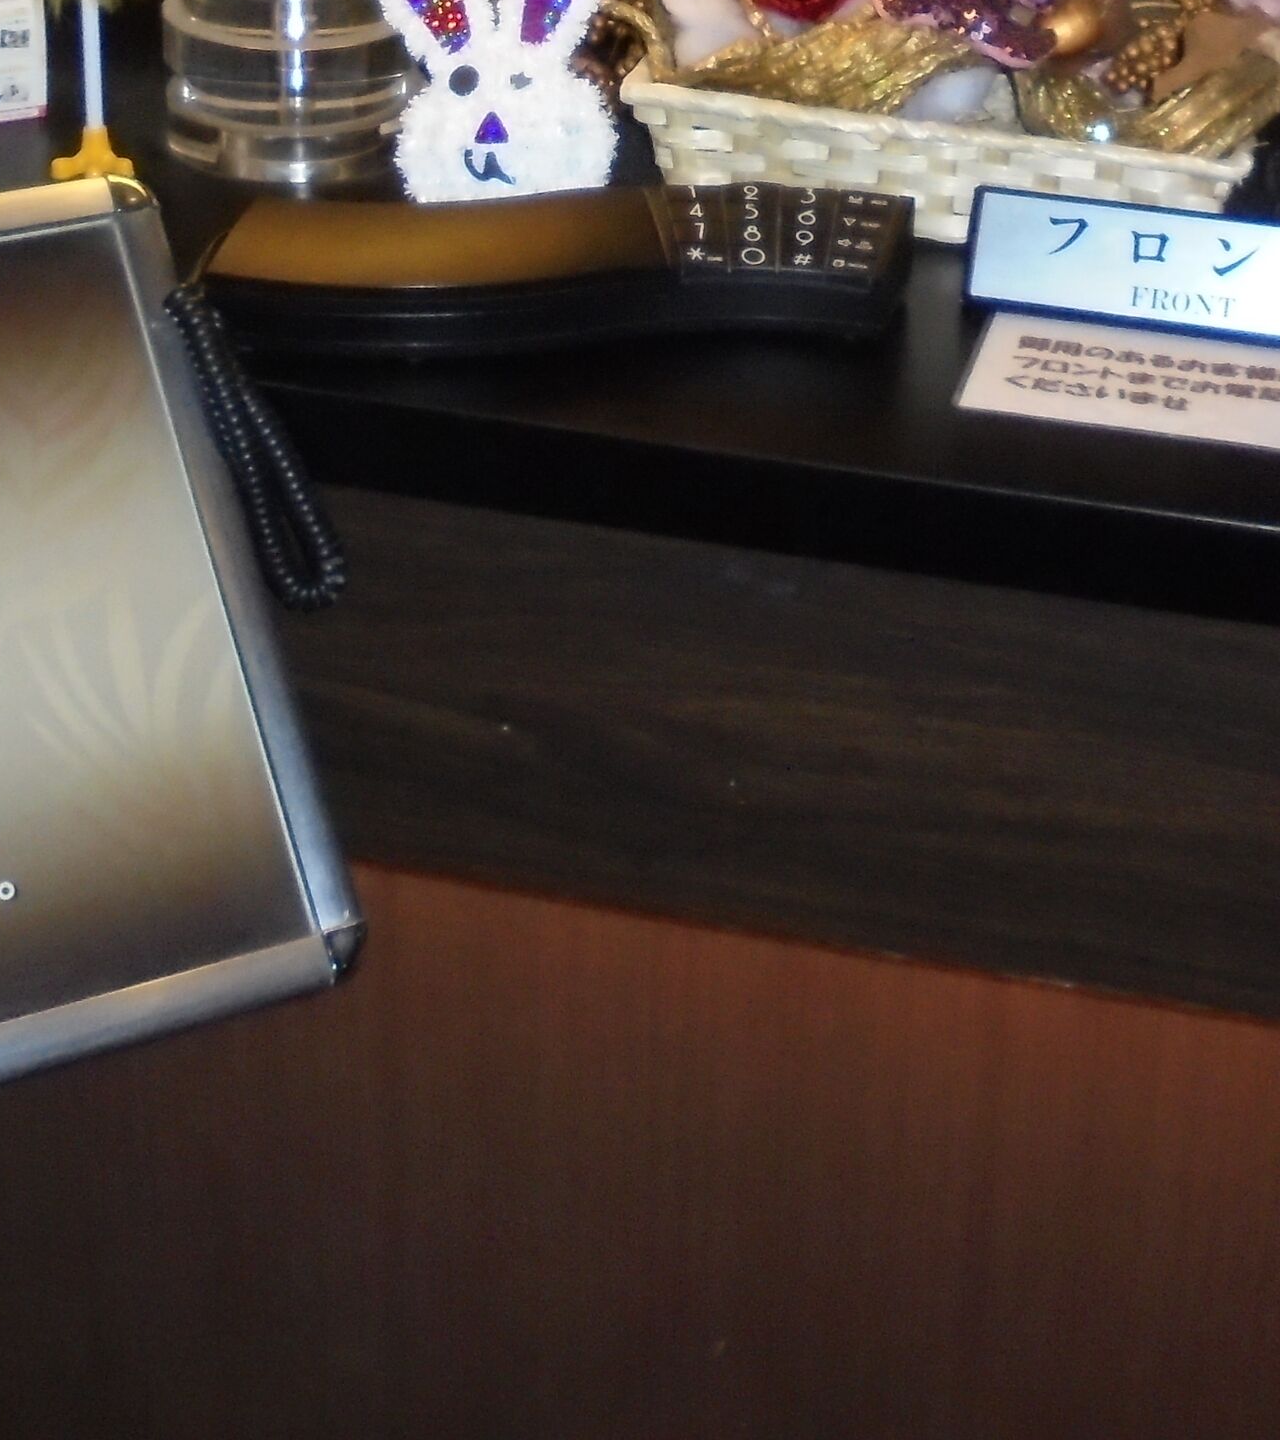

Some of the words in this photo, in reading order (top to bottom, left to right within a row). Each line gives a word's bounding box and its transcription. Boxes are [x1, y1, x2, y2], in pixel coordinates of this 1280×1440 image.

[743, 186, 759, 201] 2
[800, 187, 816, 205] 3
[689, 203, 704, 218] 4
[744, 204, 759, 220] 5
[797, 210, 816, 226] 6
[694, 222, 705, 240] 7
[743, 225, 762, 242] 8
[795, 230, 814, 246] 9
[1130, 285, 1236, 318] FRONT
[1003, 375, 1189, 411] くださいませ
